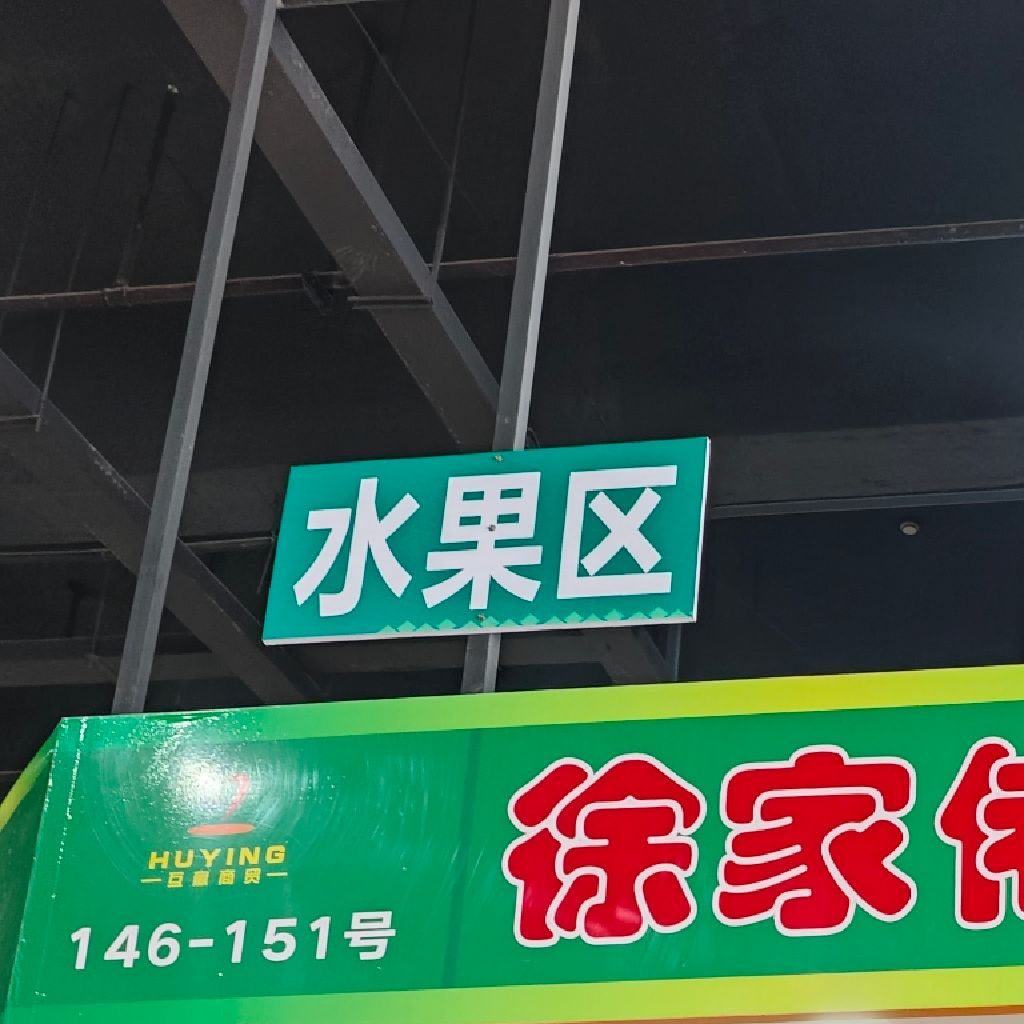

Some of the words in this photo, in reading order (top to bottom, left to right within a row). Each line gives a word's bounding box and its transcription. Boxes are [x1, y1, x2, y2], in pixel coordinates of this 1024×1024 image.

[292, 465, 678, 617] 水果区
[148, 844, 286, 870] HUYING
[70, 911, 397, 970] 146-151号
